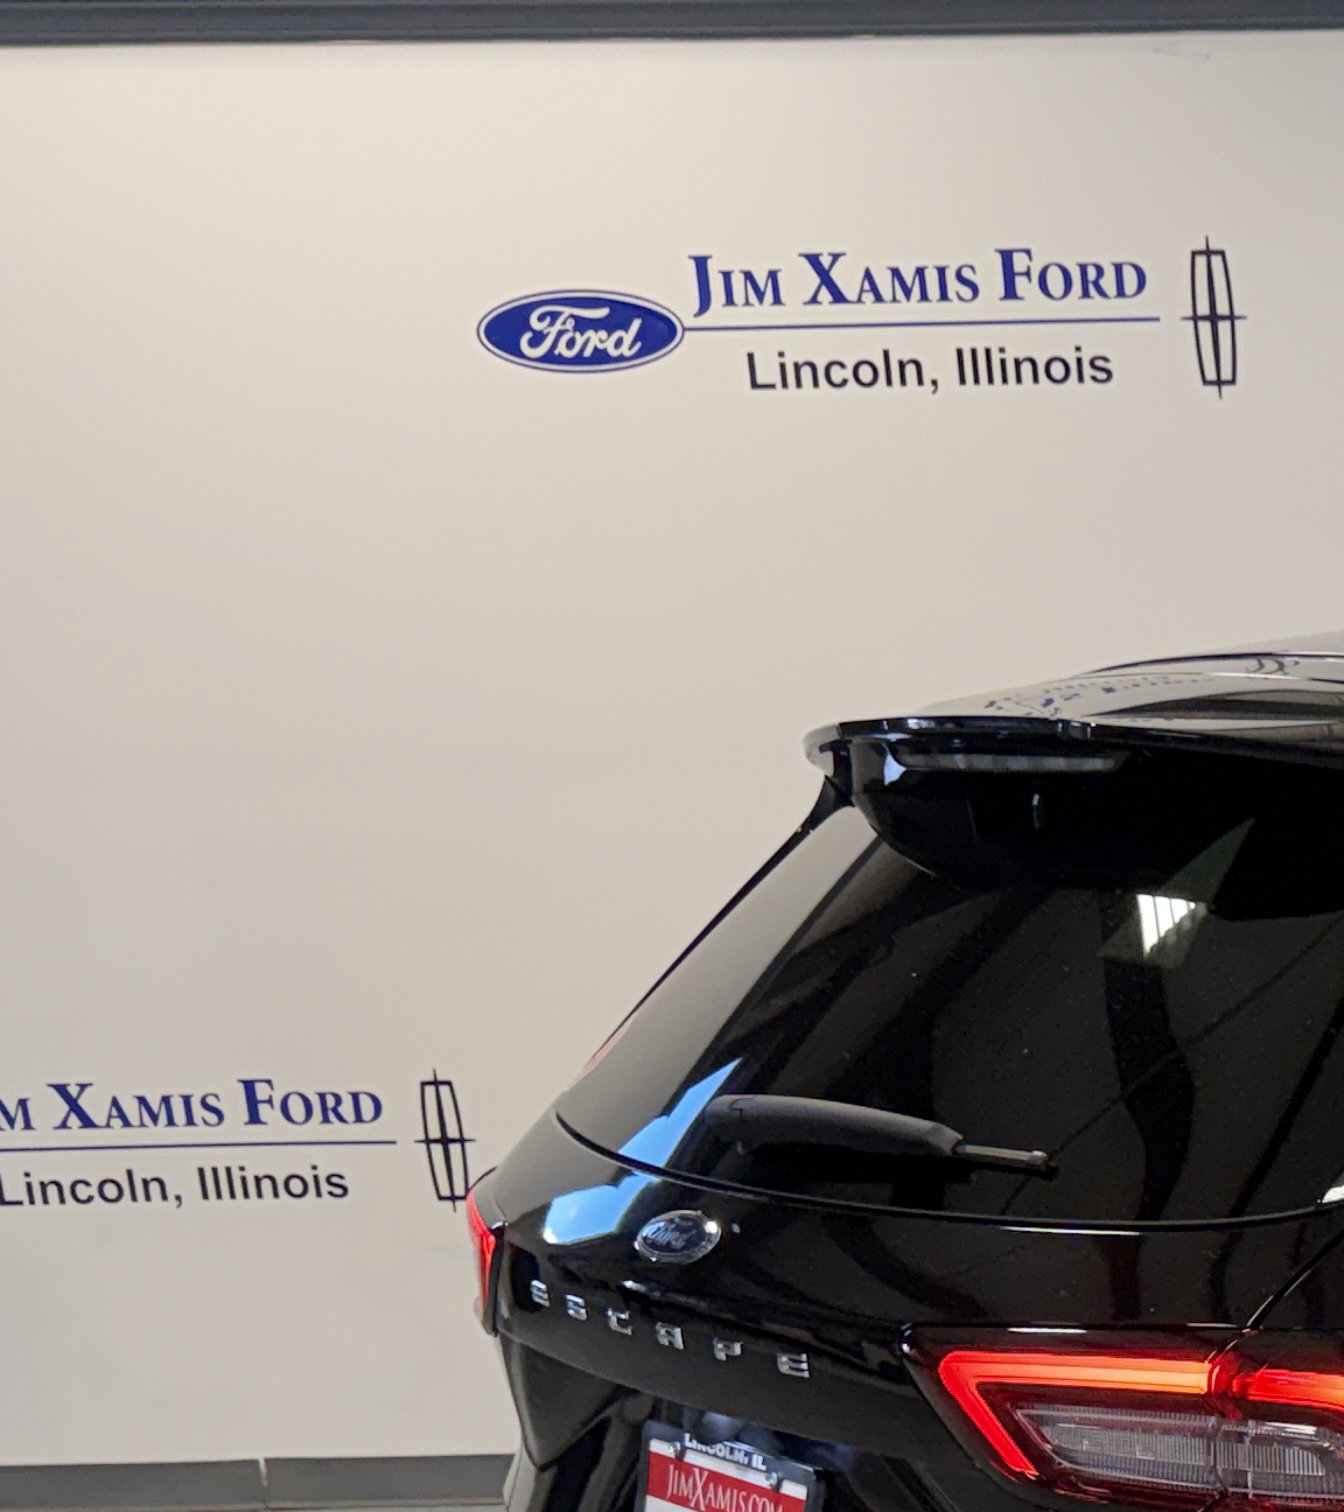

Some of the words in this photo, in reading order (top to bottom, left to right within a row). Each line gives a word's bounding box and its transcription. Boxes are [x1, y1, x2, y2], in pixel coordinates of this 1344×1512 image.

[688, 254, 787, 318] JIM
[797, 251, 981, 306] XAMIS
[994, 248, 1148, 302] FORD
[520, 305, 642, 360] Ford
[746, 348, 940, 394] Lincoln,
[956, 346, 1114, 387] Illinois
[46, 1082, 226, 1131] XAMIS
[236, 1078, 384, 1126] FORD
[0, 1168, 183, 1208] Lincoln,
[197, 1164, 349, 1201] Illinois
[529, 1279, 811, 1379] ESCAPE
